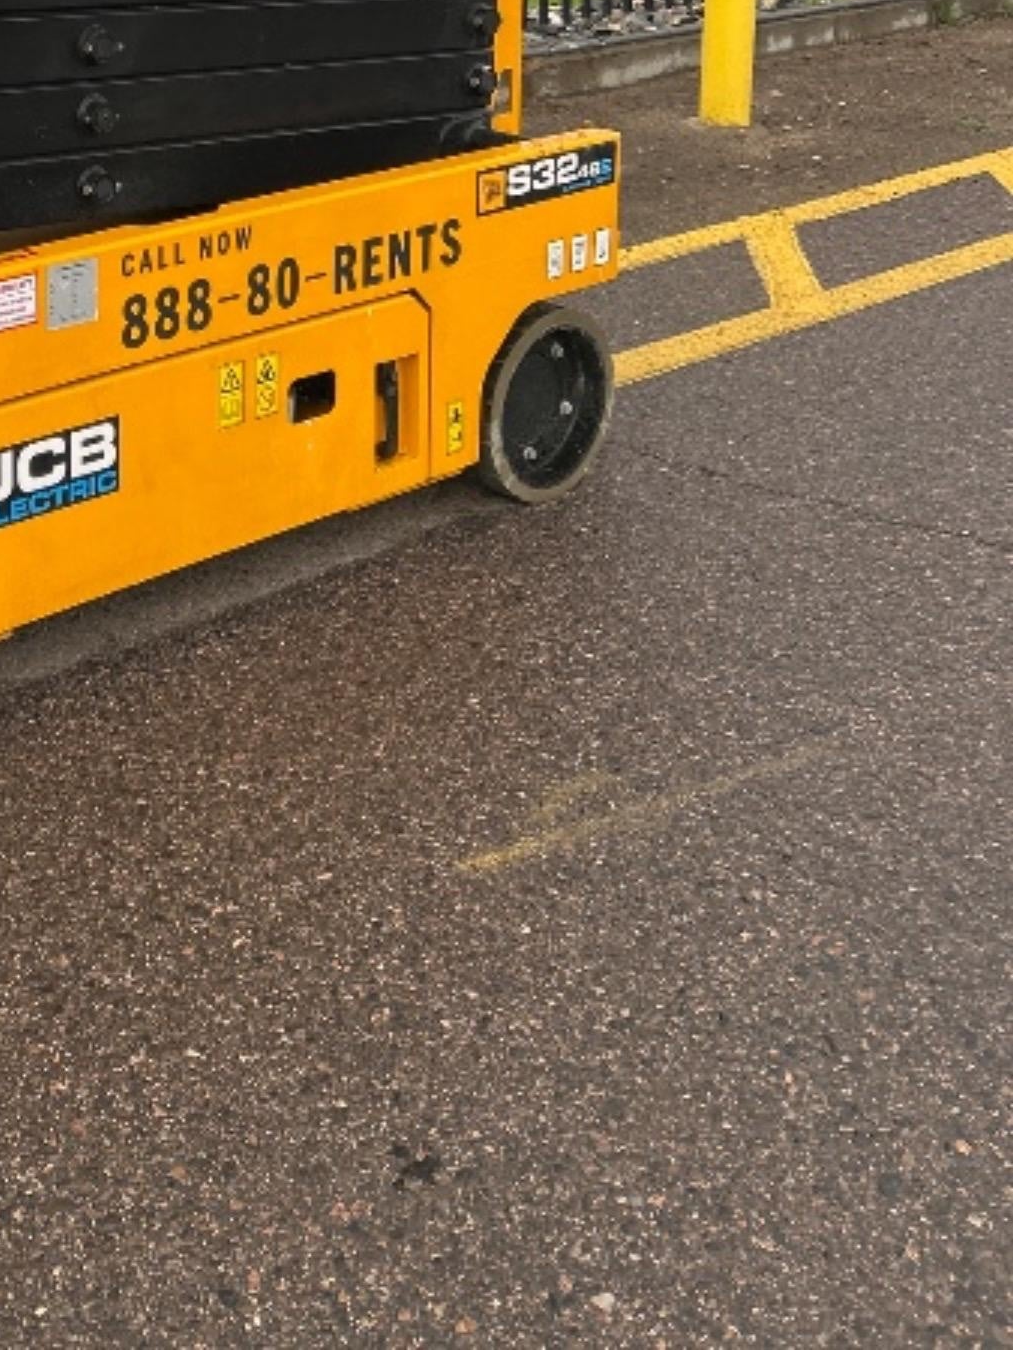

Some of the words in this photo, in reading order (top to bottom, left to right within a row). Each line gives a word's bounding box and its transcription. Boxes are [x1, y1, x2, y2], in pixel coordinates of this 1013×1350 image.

[121, 242, 186, 277] CALL
[199, 227, 253, 259] NOW
[121, 218, 462, 348] 888-80-RENTS
